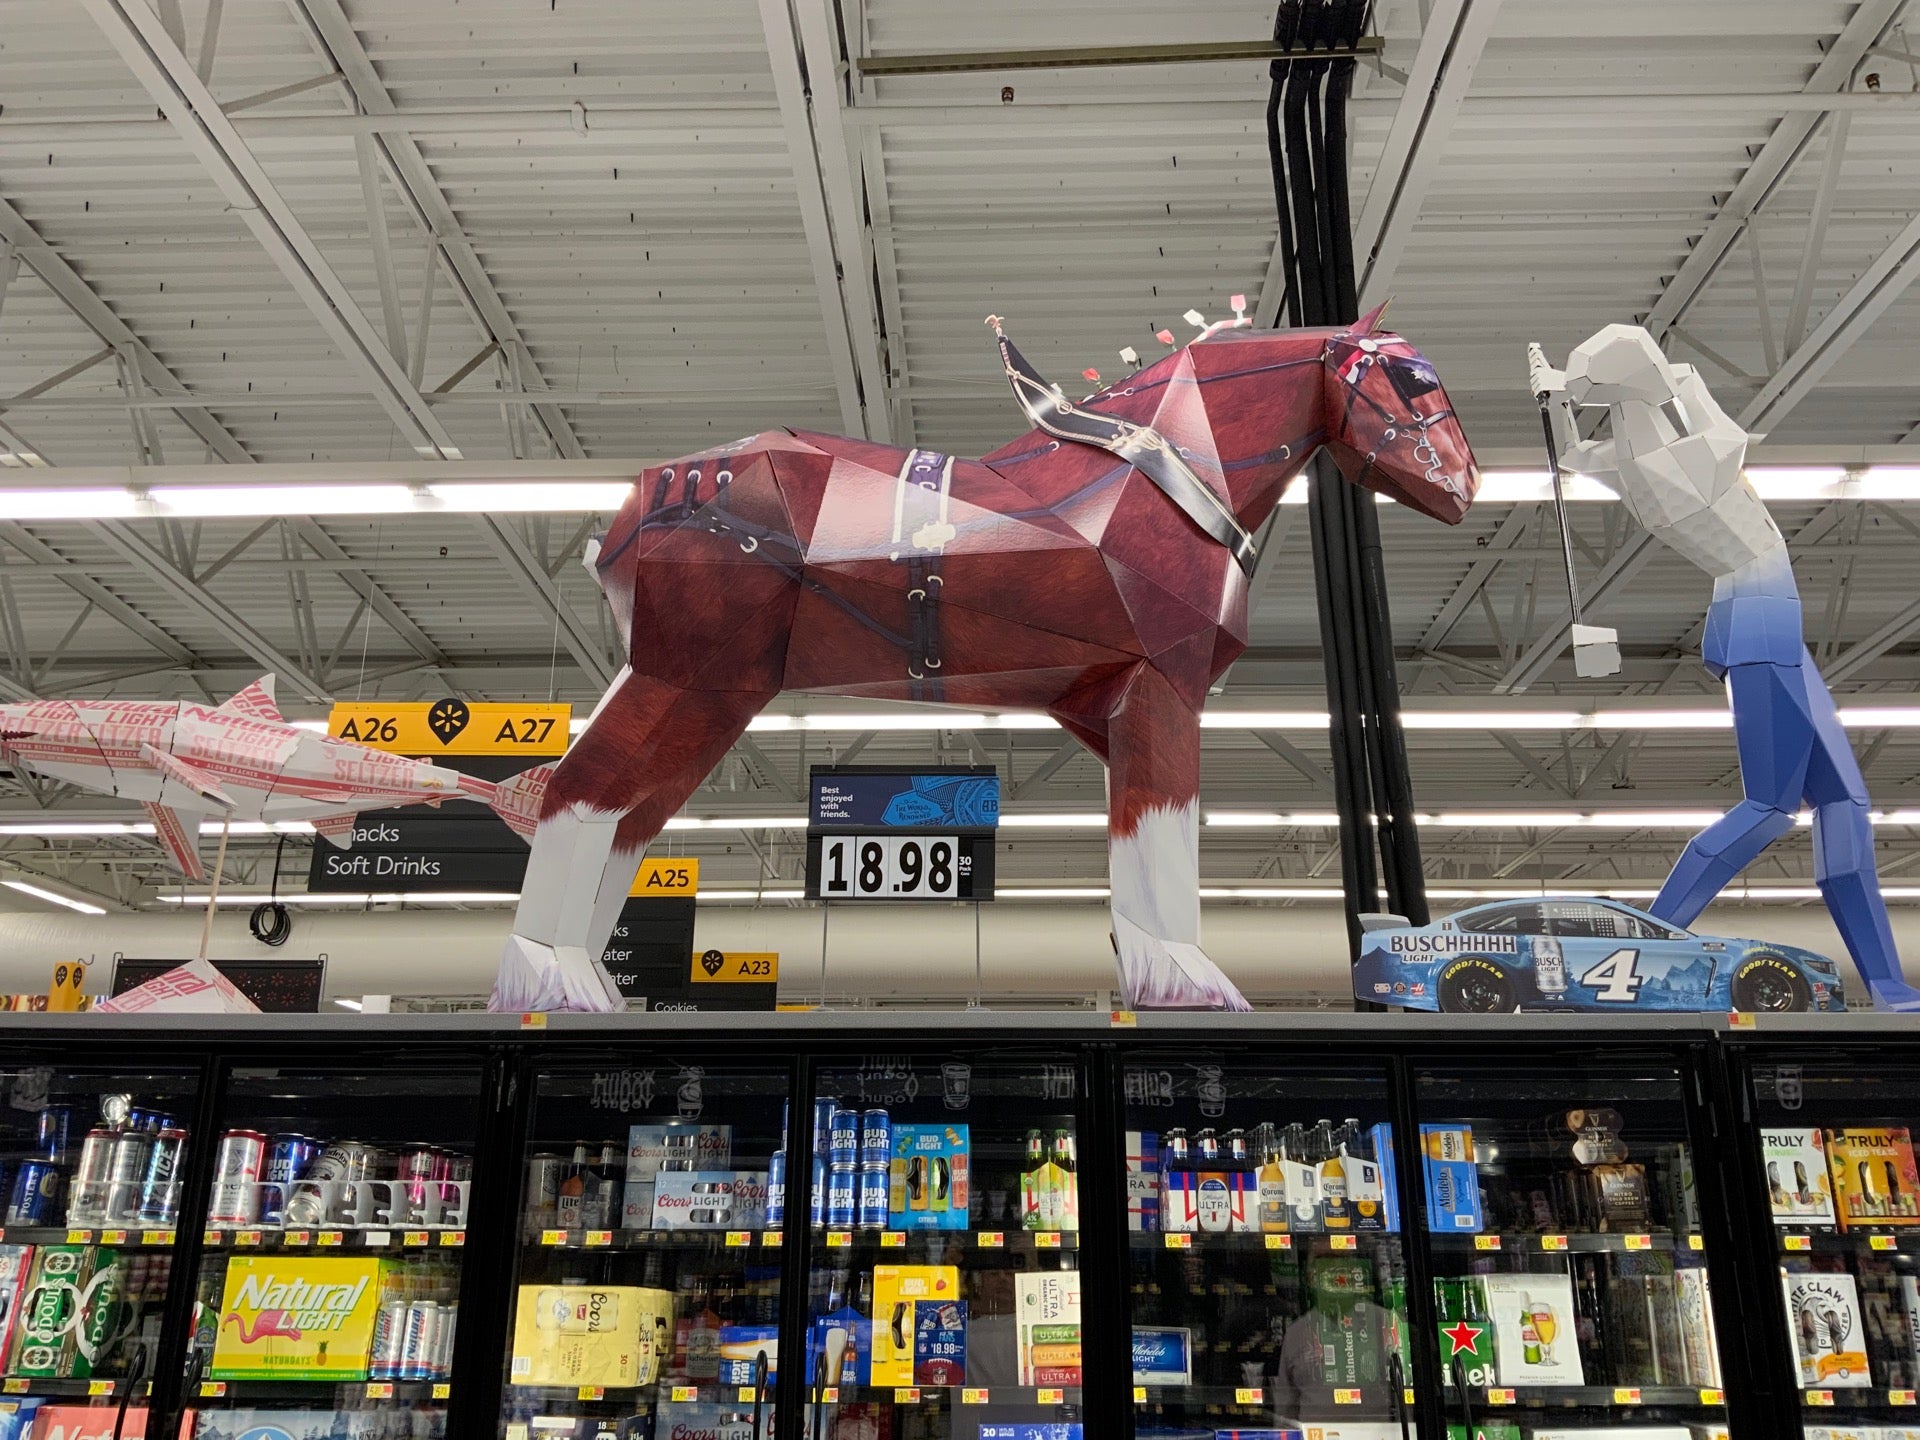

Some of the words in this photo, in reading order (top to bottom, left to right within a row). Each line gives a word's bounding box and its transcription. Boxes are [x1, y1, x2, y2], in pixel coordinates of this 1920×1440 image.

[27, 708, 80, 720] LIGH
[105, 711, 175, 727] LIGHT
[182, 706, 301, 736] Natural
[340, 717, 398, 742] A26
[495, 719, 556, 743] A27
[224, 729, 288, 748] LIGHT
[190, 735, 276, 770] SELTZER
[206, 763, 227, 771] ALOHA
[229, 767, 259, 777] BEACHES
[334, 759, 416, 789] SELTZER
[516, 779, 543, 796] LIG
[821, 786, 839, 794] Best
[496, 784, 543, 818] SELTZ
[327, 856, 370, 875] Soft
[376, 855, 441, 876] Drinks
[828, 841, 952, 893] 18.98
[959, 856, 972, 866] 30
[646, 869, 689, 887] A25
[1391, 936, 1515, 951] BUSCHHHHH
[603, 949, 633, 961] ater
[738, 961, 770, 975] A23
[1581, 948, 1643, 1003] 4
[655, 1002, 698, 1012] Cookies
[698, 1133, 729, 1149] Coor
[831, 1129, 855, 1139] BUD
[863, 1129, 887, 1139] BUD
[919, 1135, 939, 1143] BUD
[1847, 1135, 1894, 1147] TRULY
[663, 1149, 692, 1157] LIGHT
[915, 1142, 942, 1150] LIGHT
[155, 1148, 174, 1177] ICE
[1366, 1168, 1371, 1176] 6
[733, 1179, 768, 1199] Coor
[829, 1188, 852, 1198] BUD
[862, 1188, 886, 1198] BUD
[1262, 1188, 1284, 1196] Corona
[1324, 1183, 1346, 1191] Corona
[1440, 1172, 1450, 1207] Modelo
[562, 1197, 580, 1209] Lite
[658, 1193, 692, 1207] Coors
[694, 1196, 727, 1206] LIGHT
[1200, 1201, 1230, 1209] ULTRA
[231, 1274, 370, 1311] Natural
[1049, 1279, 1058, 1318] ULTRA
[1807, 1282, 1845, 1303] CLAW
[588, 1293, 607, 1333] Coors
[276, 1310, 352, 1331] LIGHT
[620, 1354, 628, 1365] 30
[1344, 1331, 1356, 1383] Heineken
[1041, 1371, 1070, 1380] ULTRA
[983, 1428, 995, 1437] 20
[1310, 1430, 1320, 1440] 12
